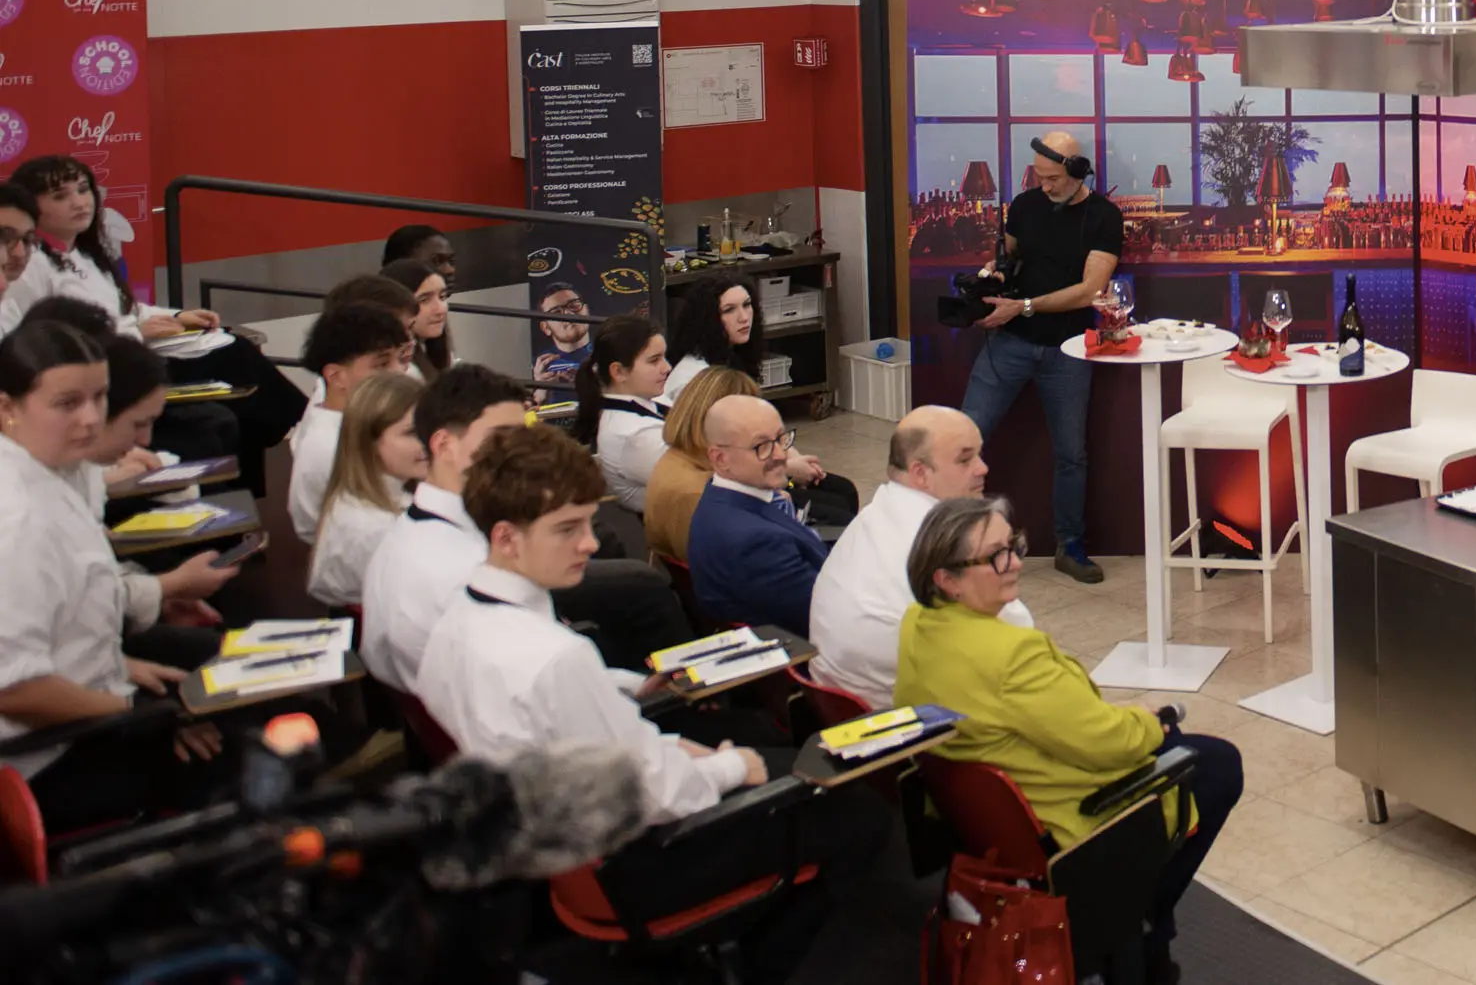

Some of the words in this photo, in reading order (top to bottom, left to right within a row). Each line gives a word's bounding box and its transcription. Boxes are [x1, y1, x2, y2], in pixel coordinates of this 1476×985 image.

[100, 2, 138, 12] NOTTE
[79, 40, 133, 67] SCHOOL
[527, 50, 563, 68] Cast
[79, 65, 131, 91] EDITION
[540, 85, 562, 93] CORSI
[563, 84, 600, 92] TRIENNALI
[68, 111, 116, 146] Chef
[104, 132, 142, 143] NOTTE
[560, 132, 608, 140] FORMAZIONE
[569, 180, 627, 189] PROFESSIONALE
